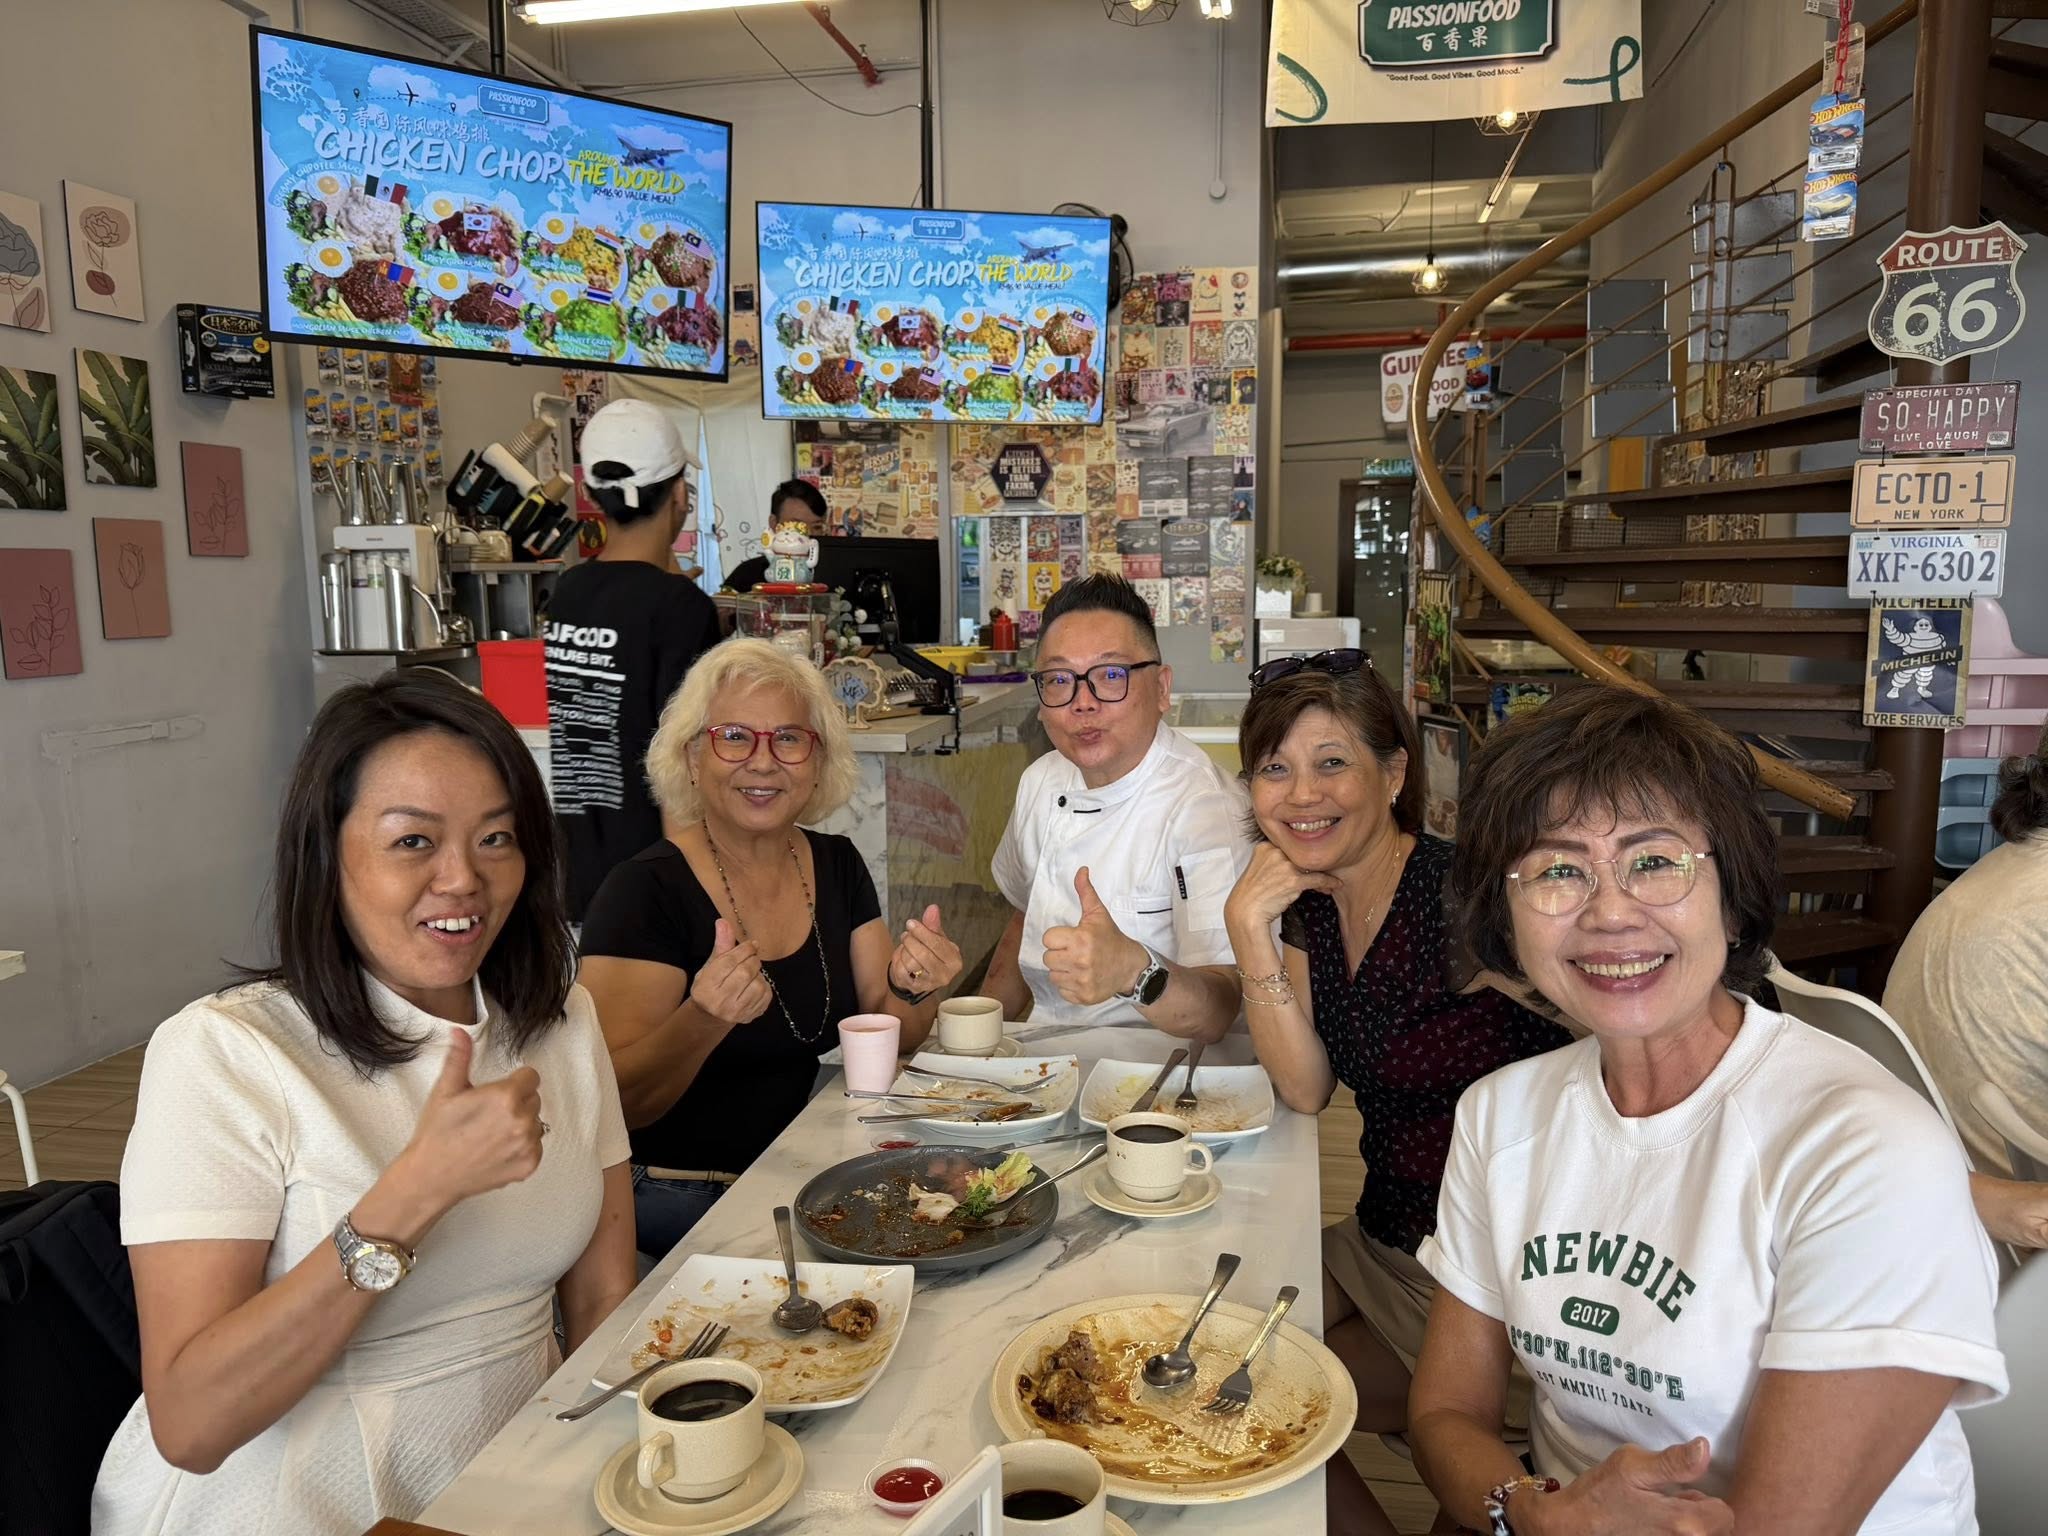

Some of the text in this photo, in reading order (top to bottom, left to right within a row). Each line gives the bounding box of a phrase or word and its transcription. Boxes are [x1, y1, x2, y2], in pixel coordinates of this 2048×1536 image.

[1387, 0, 1521, 30] PASSIONFOOD
[1416, 25, 1488, 52] 百香果
[1476, 69, 1496, 77] Good
[314, 128, 564, 184] CHICKEN CHOP
[568, 160, 686, 195] THE WORLD
[625, 191, 649, 202] VALUE
[1897, 236, 2004, 267] ROUTE
[795, 260, 974, 289] CHICKEN CHOP
[978, 263, 1073, 284] THE WORLD
[1893, 277, 1997, 346] 66
[1431, 378, 1460, 392] OOD
[1896, 387, 1949, 399] SPECIAL
[1955, 386, 1983, 397] DAY
[1893, 430, 1979, 442] LIVE LAUGH
[1919, 441, 1952, 450] LOVE
[1875, 471, 1986, 504] ECTO-1
[1894, 508, 1965, 520] NEW YORK
[1890, 536, 1964, 548] VIRGINIA
[1856, 550, 1996, 582] XKF-6302
[1872, 597, 1973, 608] MICHELIN
[1880, 650, 1957, 672] MICHELIN
[1864, 713, 1964, 727] TYRE SERVICES
[1521, 1231, 1697, 1323] NEWBIE
[1570, 1303, 1611, 1328] 2017
[1536, 1370, 1555, 1385] EST
[1559, 1377, 1608, 1402] MMXVII
